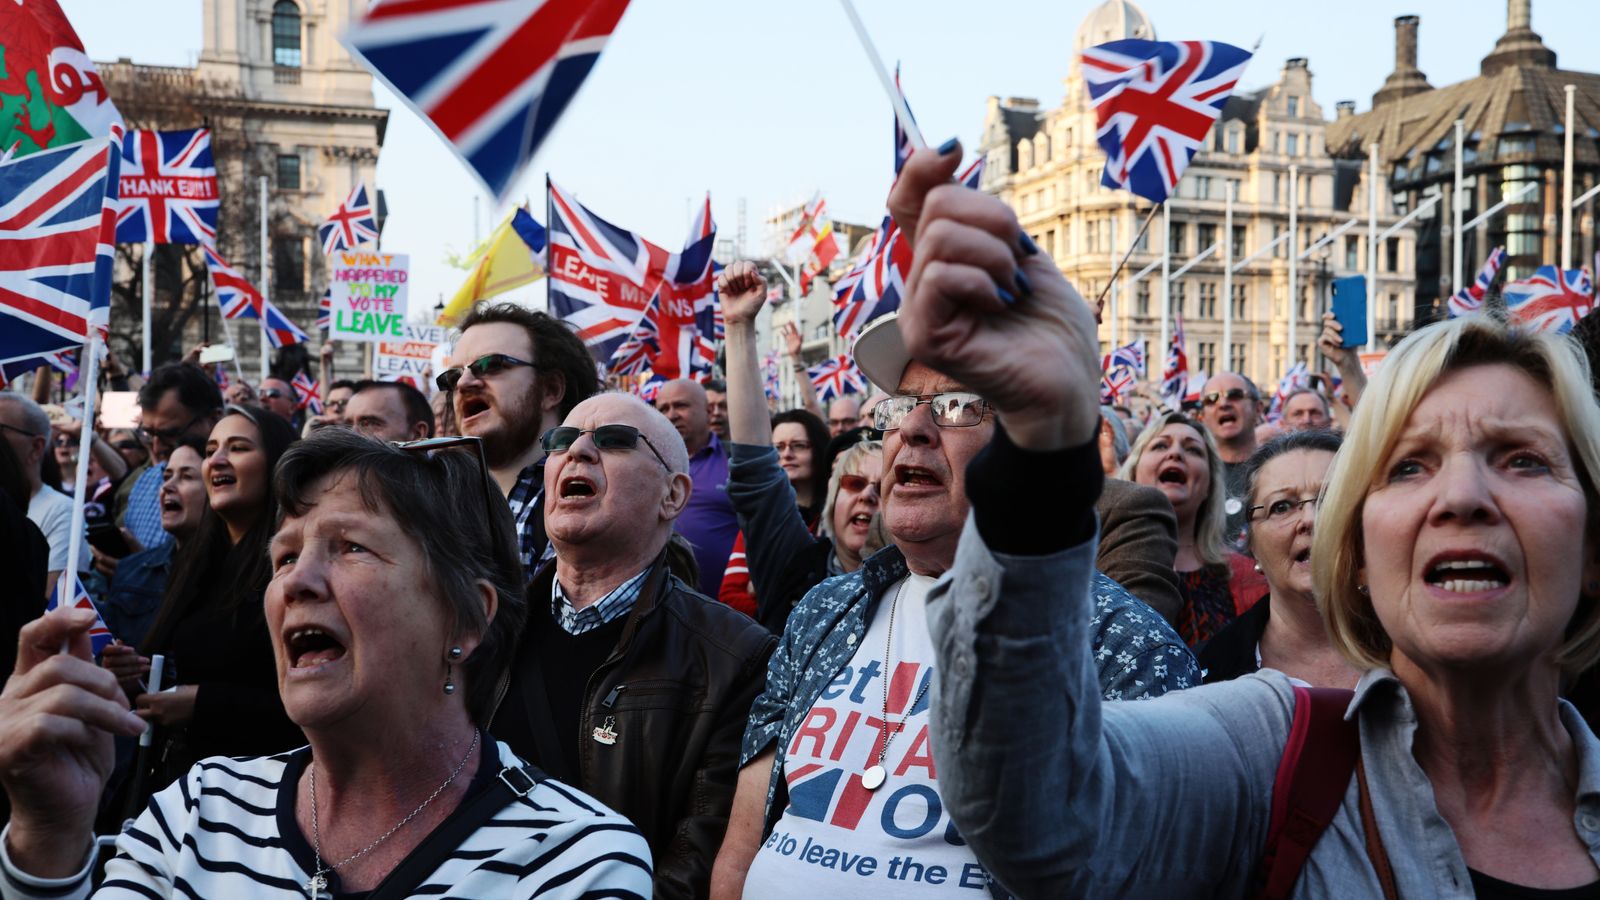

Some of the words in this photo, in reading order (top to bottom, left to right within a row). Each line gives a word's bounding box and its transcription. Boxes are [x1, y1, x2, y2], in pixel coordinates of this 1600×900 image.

[341, 252, 394, 267] WHAT
[335, 269, 408, 283] HAPPENED
[347, 283, 371, 297] TO
[374, 284, 399, 298] MY
[348, 296, 393, 312] VOTE
[620, 284, 695, 318] MENS
[336, 310, 404, 336] LEAVE
[406, 326, 440, 342] AVE
[377, 356, 428, 374] LEAV
[821, 660, 881, 704] et
[789, 706, 937, 780] RITA
[775, 832, 797, 856] to
[799, 837, 878, 876] leave
[887, 856, 948, 884] the
[958, 863, 985, 889] E
